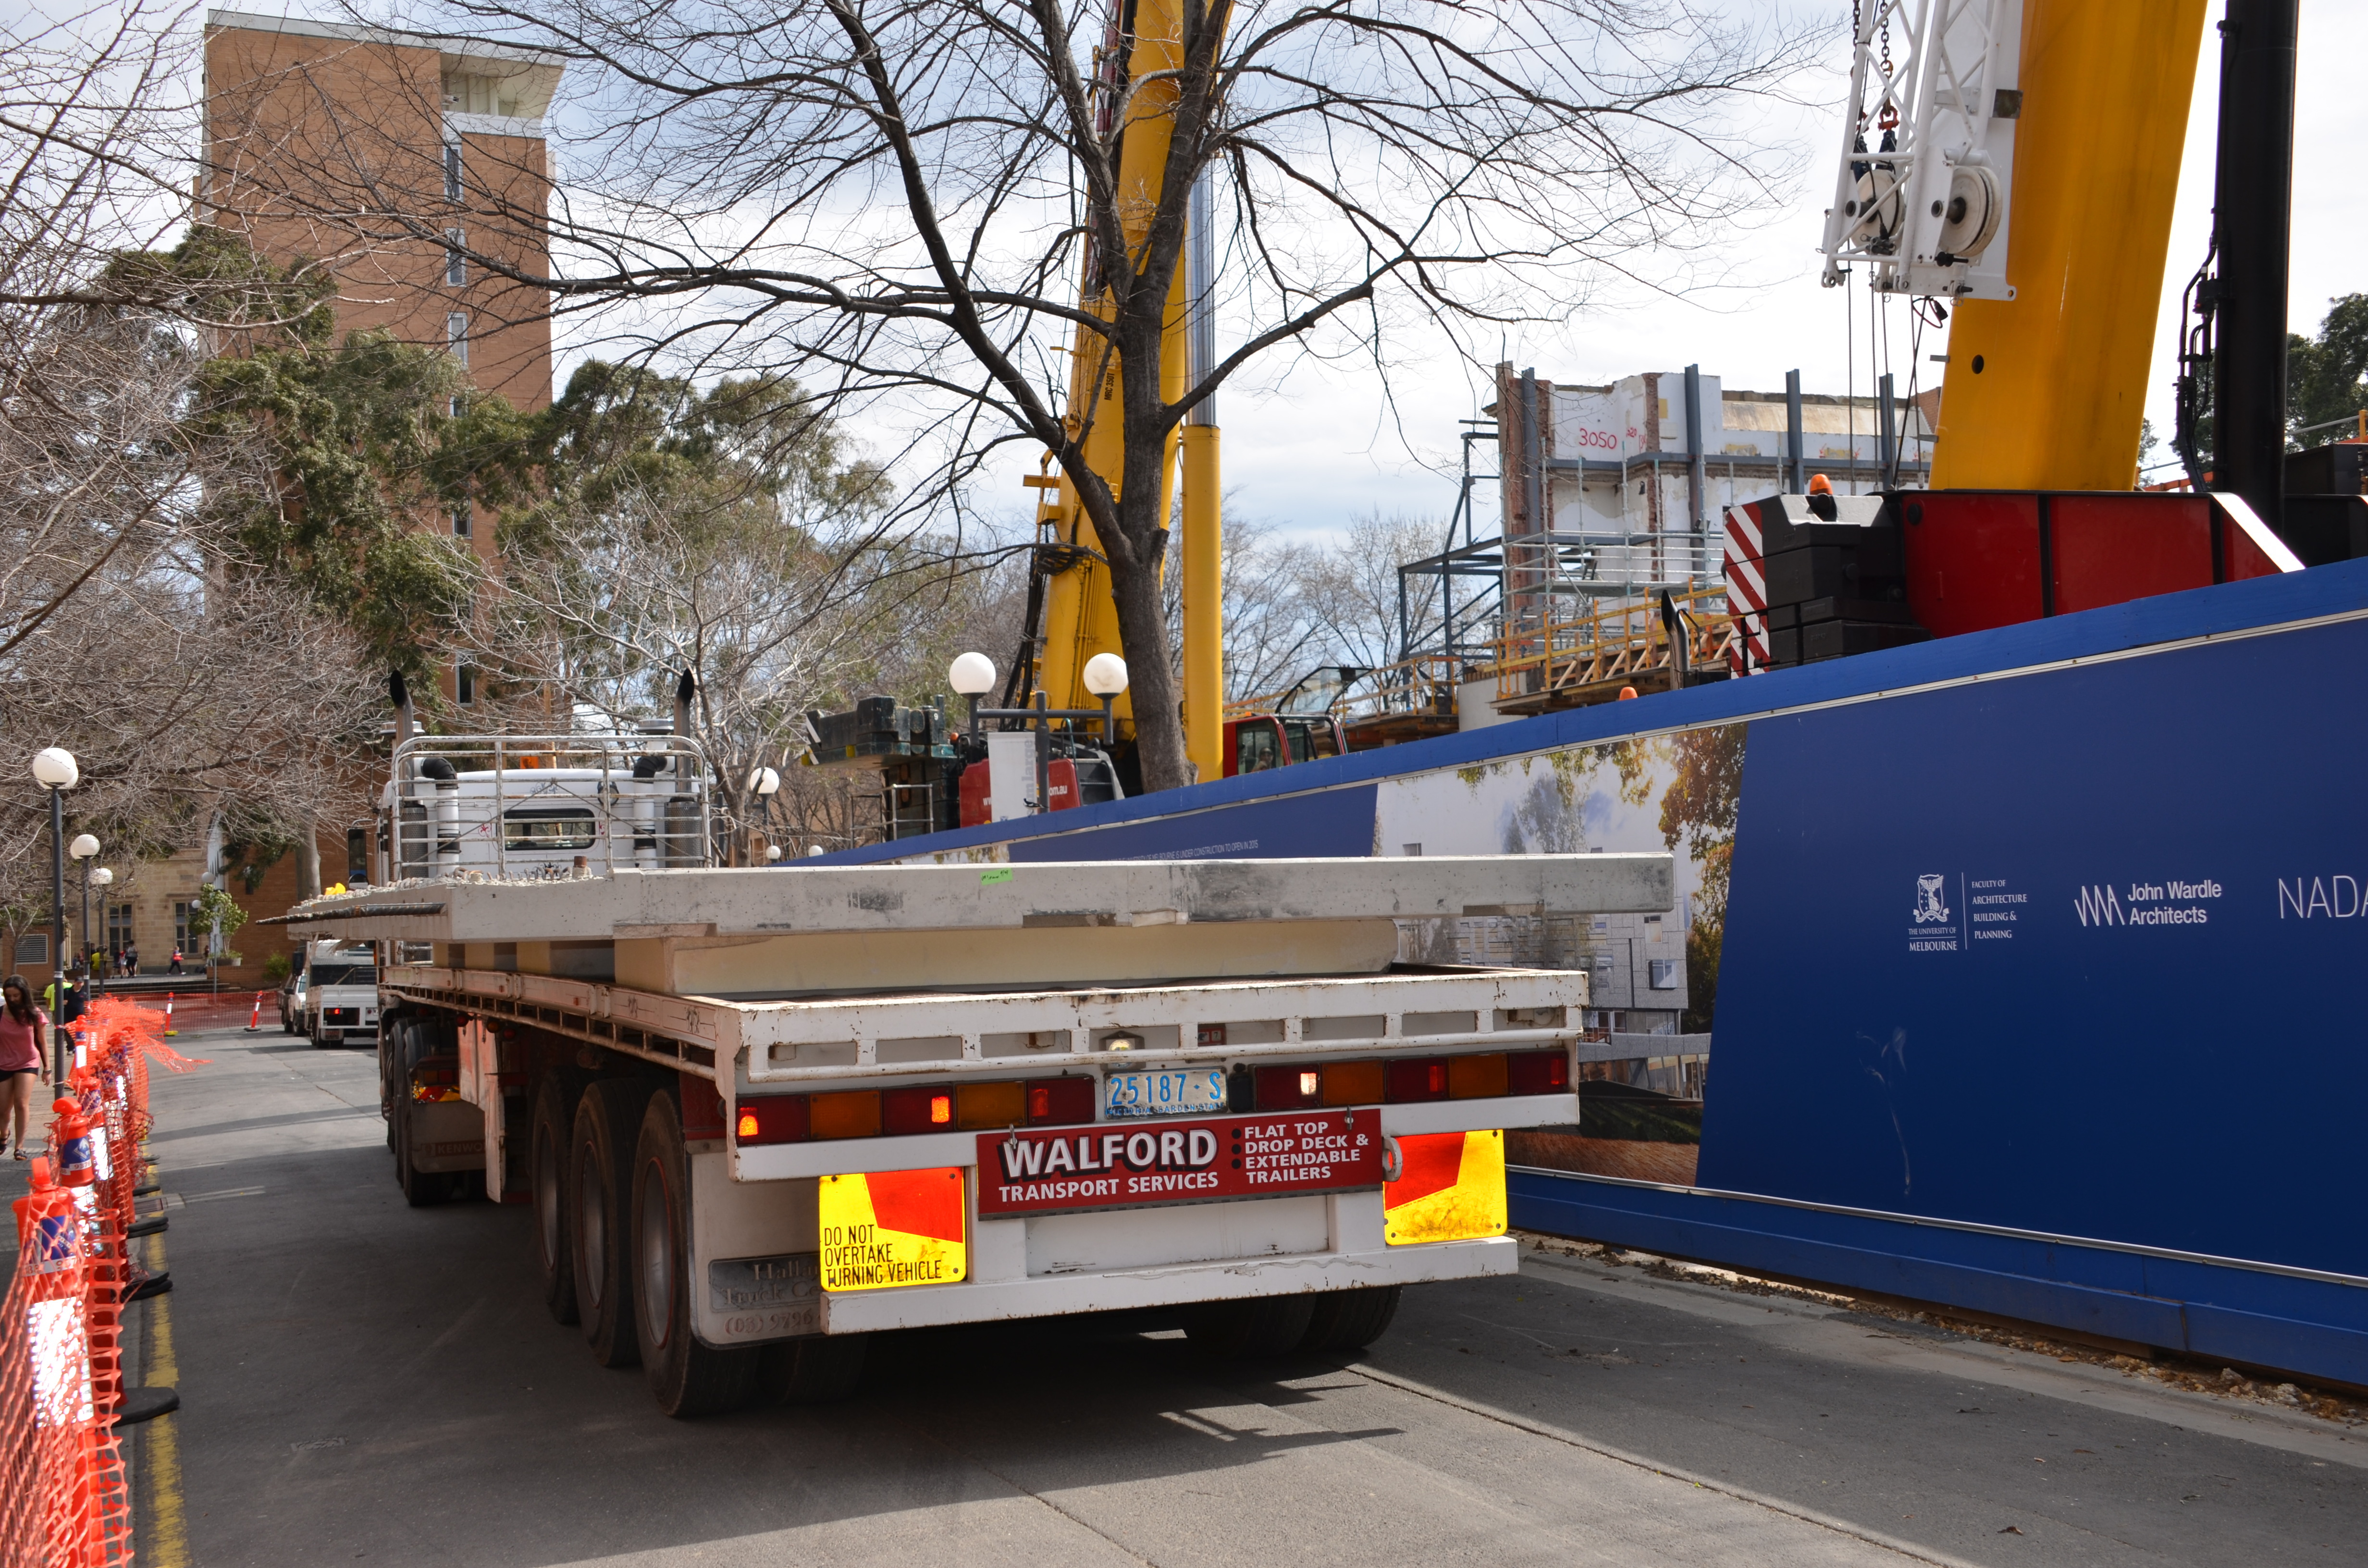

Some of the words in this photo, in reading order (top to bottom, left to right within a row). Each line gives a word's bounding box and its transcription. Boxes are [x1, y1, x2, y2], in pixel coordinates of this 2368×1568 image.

[1106, 372, 1115, 387] 350T
[1104, 387, 1113, 401] MRC
[1021, 739, 1036, 782] large
[1194, 845, 1225, 857] CONSTRUCTION
[1232, 842, 1244, 851] OPEN
[1972, 880, 1997, 888] FACULTY
[2128, 883, 2163, 901] John
[2167, 880, 2222, 899] Wardle
[1972, 894, 2027, 905] ARCHITECTURE
[2279, 875, 2368, 919] NAD
[1973, 912, 2008, 921] BUILDING
[2010, 911, 2017, 920] &
[2130, 906, 2207, 925] Architects
[1974, 930, 2012, 939] PLANNING
[1909, 941, 1957, 951] MELBOURNE
[1159, 1105, 1195, 1114] GARDEN
[1199, 1102, 1224, 1111] STATE
[1245, 1124, 1286, 1139] FLAT
[1295, 1122, 1328, 1135] TOP
[438, 1142, 486, 1154] KENWO
[1245, 1139, 1295, 1154] DROP
[1302, 1135, 1348, 1150] DECK
[1356, 1134, 1369, 1146] &
[1001, 1128, 1218, 1180] WALFORD
[1246, 1149, 1360, 1169] EXTENDABLE
[1246, 1166, 1331, 1184] TRAILERS
[999, 1178, 1119, 1202] TRANSPORT
[1128, 1172, 1219, 1193] SERVICES
[825, 1226, 841, 1246] DO
[849, 1224, 875, 1244] NOT
[825, 1243, 893, 1267] OVERTAKE
[826, 1264, 882, 1287] TURNING
[888, 1260, 942, 1282] VEHICLE
[721, 1284, 783, 1304] Truck
[725, 1314, 764, 1335] (03)
